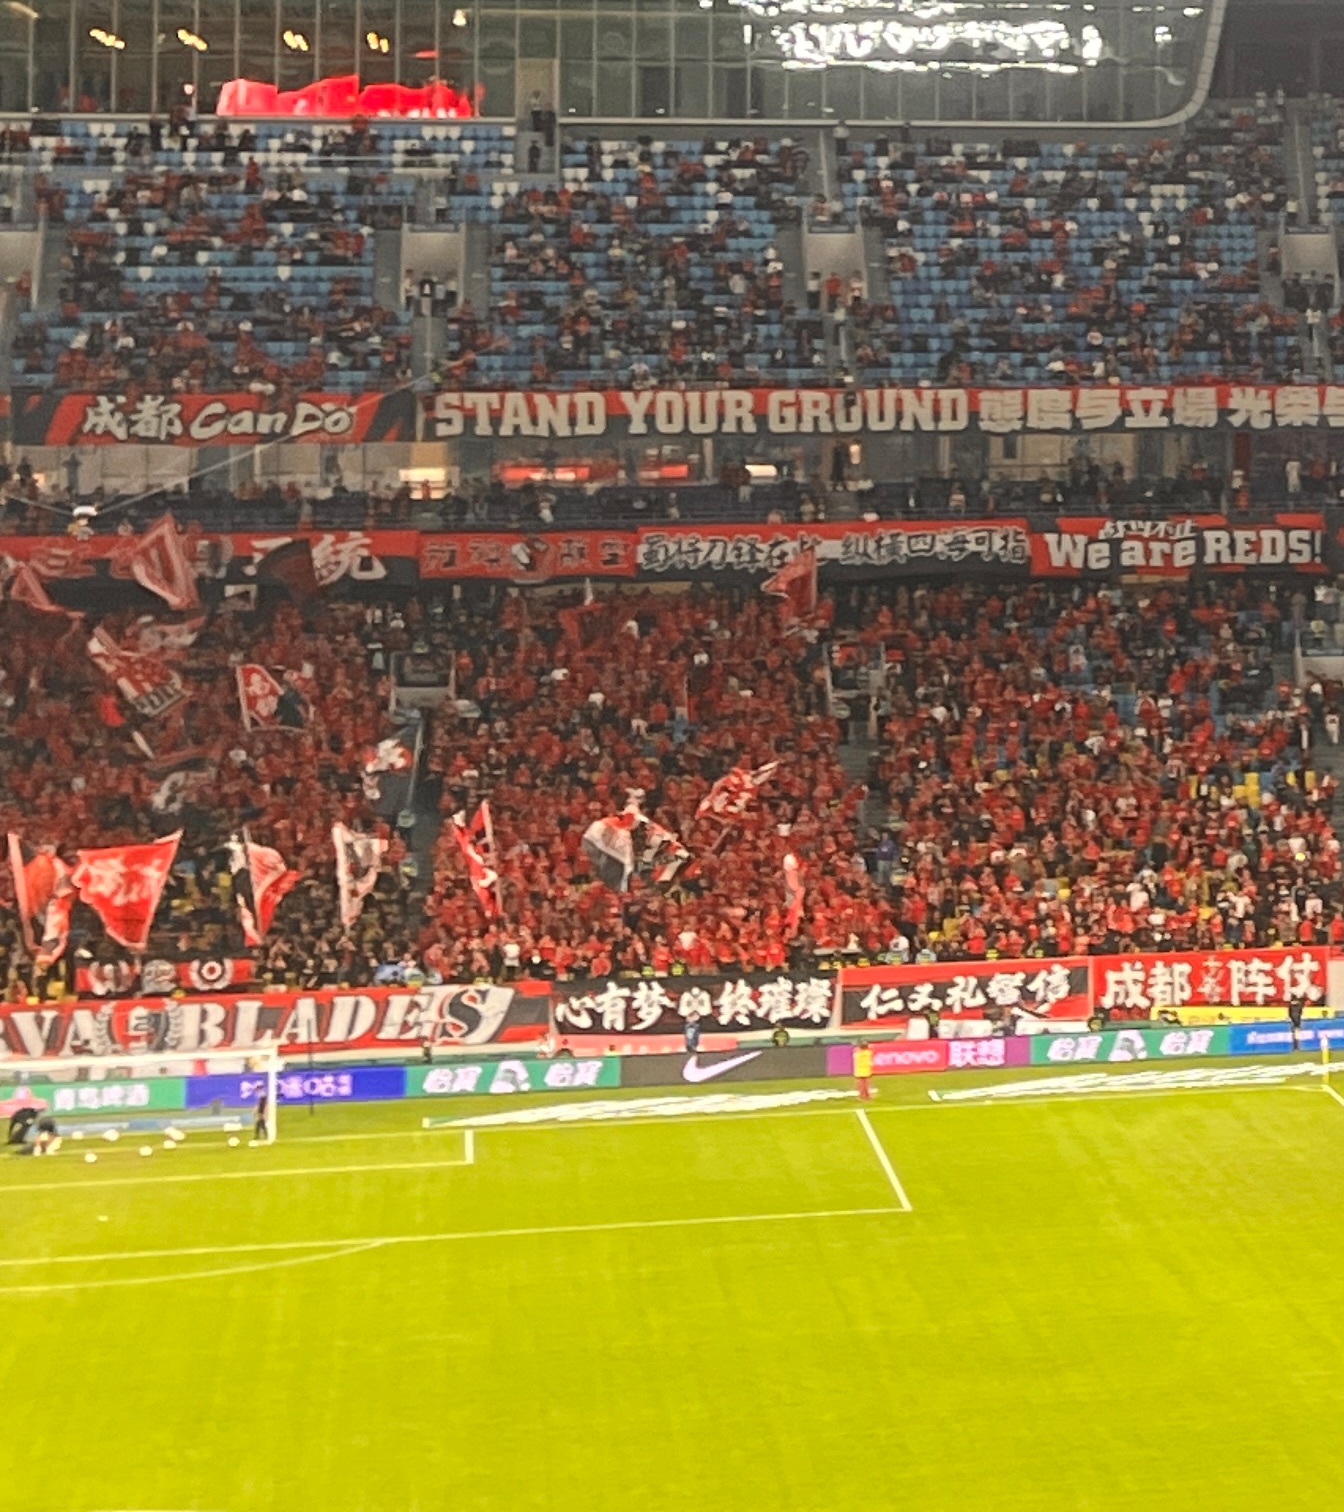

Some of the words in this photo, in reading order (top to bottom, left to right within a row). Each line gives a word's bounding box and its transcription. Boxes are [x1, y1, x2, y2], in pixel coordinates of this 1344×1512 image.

[83, 395, 183, 440] 成都
[435, 392, 606, 436] STAND
[621, 391, 757, 434] YOUR
[768, 390, 968, 433] GROUND
[1046, 533, 1111, 570] We
[1120, 539, 1196, 568] are
[1203, 529, 1322, 565] REDS!
[0, 1008, 110, 1058] VA
[177, 985, 514, 1050] BLADES
[872, 1050, 940, 1066] enovo
